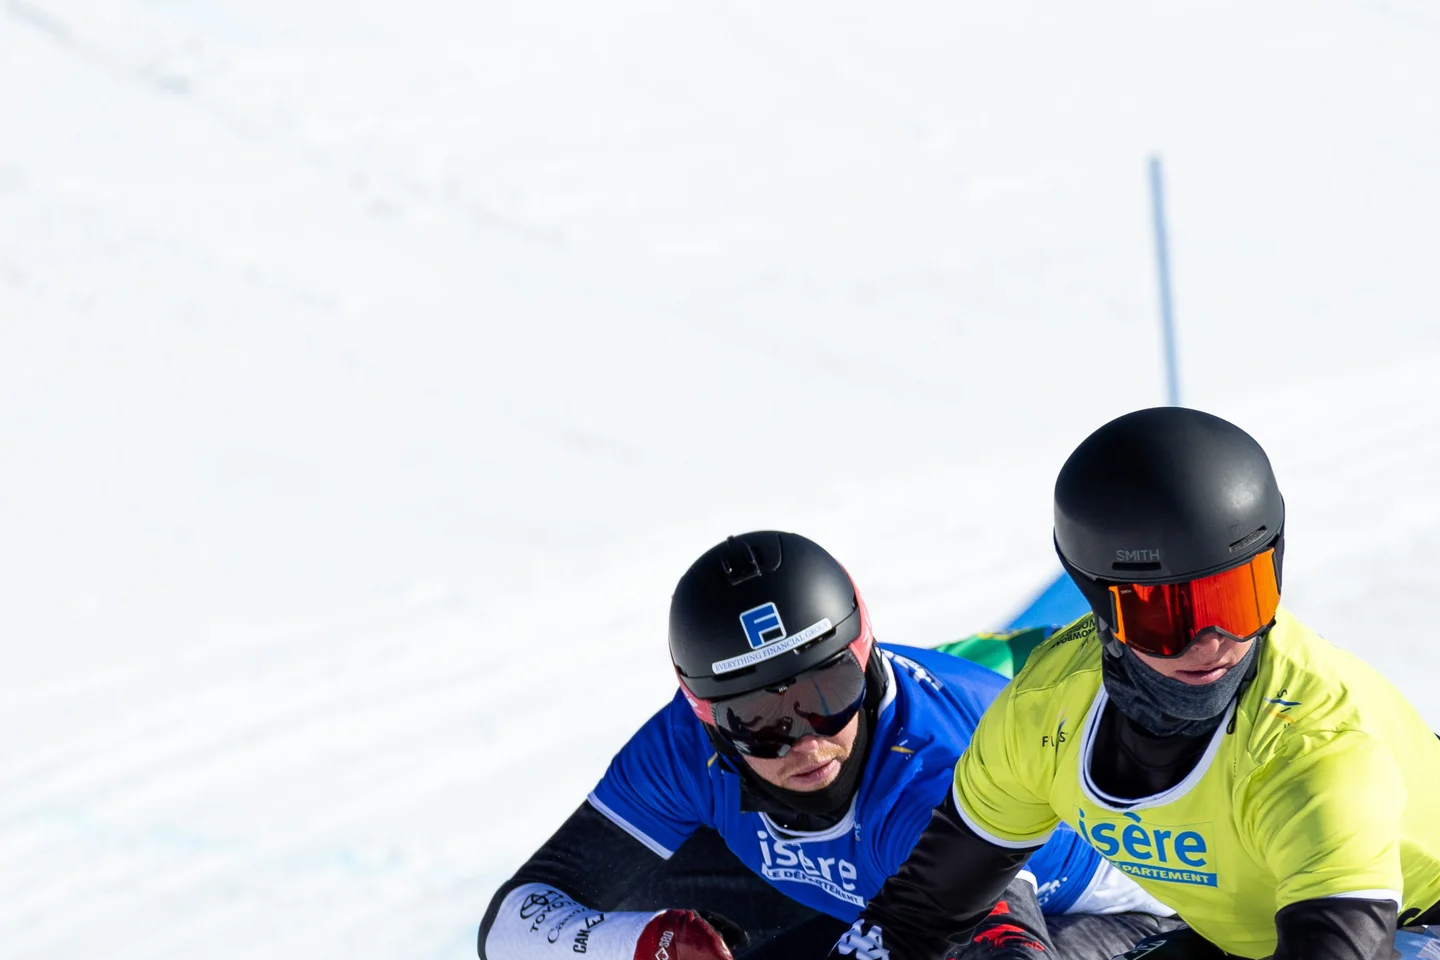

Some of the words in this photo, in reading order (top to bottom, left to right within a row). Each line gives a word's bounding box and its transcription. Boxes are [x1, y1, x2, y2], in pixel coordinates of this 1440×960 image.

[1116, 549, 1160, 561] SMITH
[715, 651, 762, 673] EVERYTHING
[763, 635, 805, 657] FINANCIAL
[804, 621, 829, 638] GROUP
[1042, 731, 1067, 748] FIS
[1078, 807, 1207, 868] isère
[1115, 862, 1209, 884] PARTEMENT
[573, 928, 591, 954] CAN
